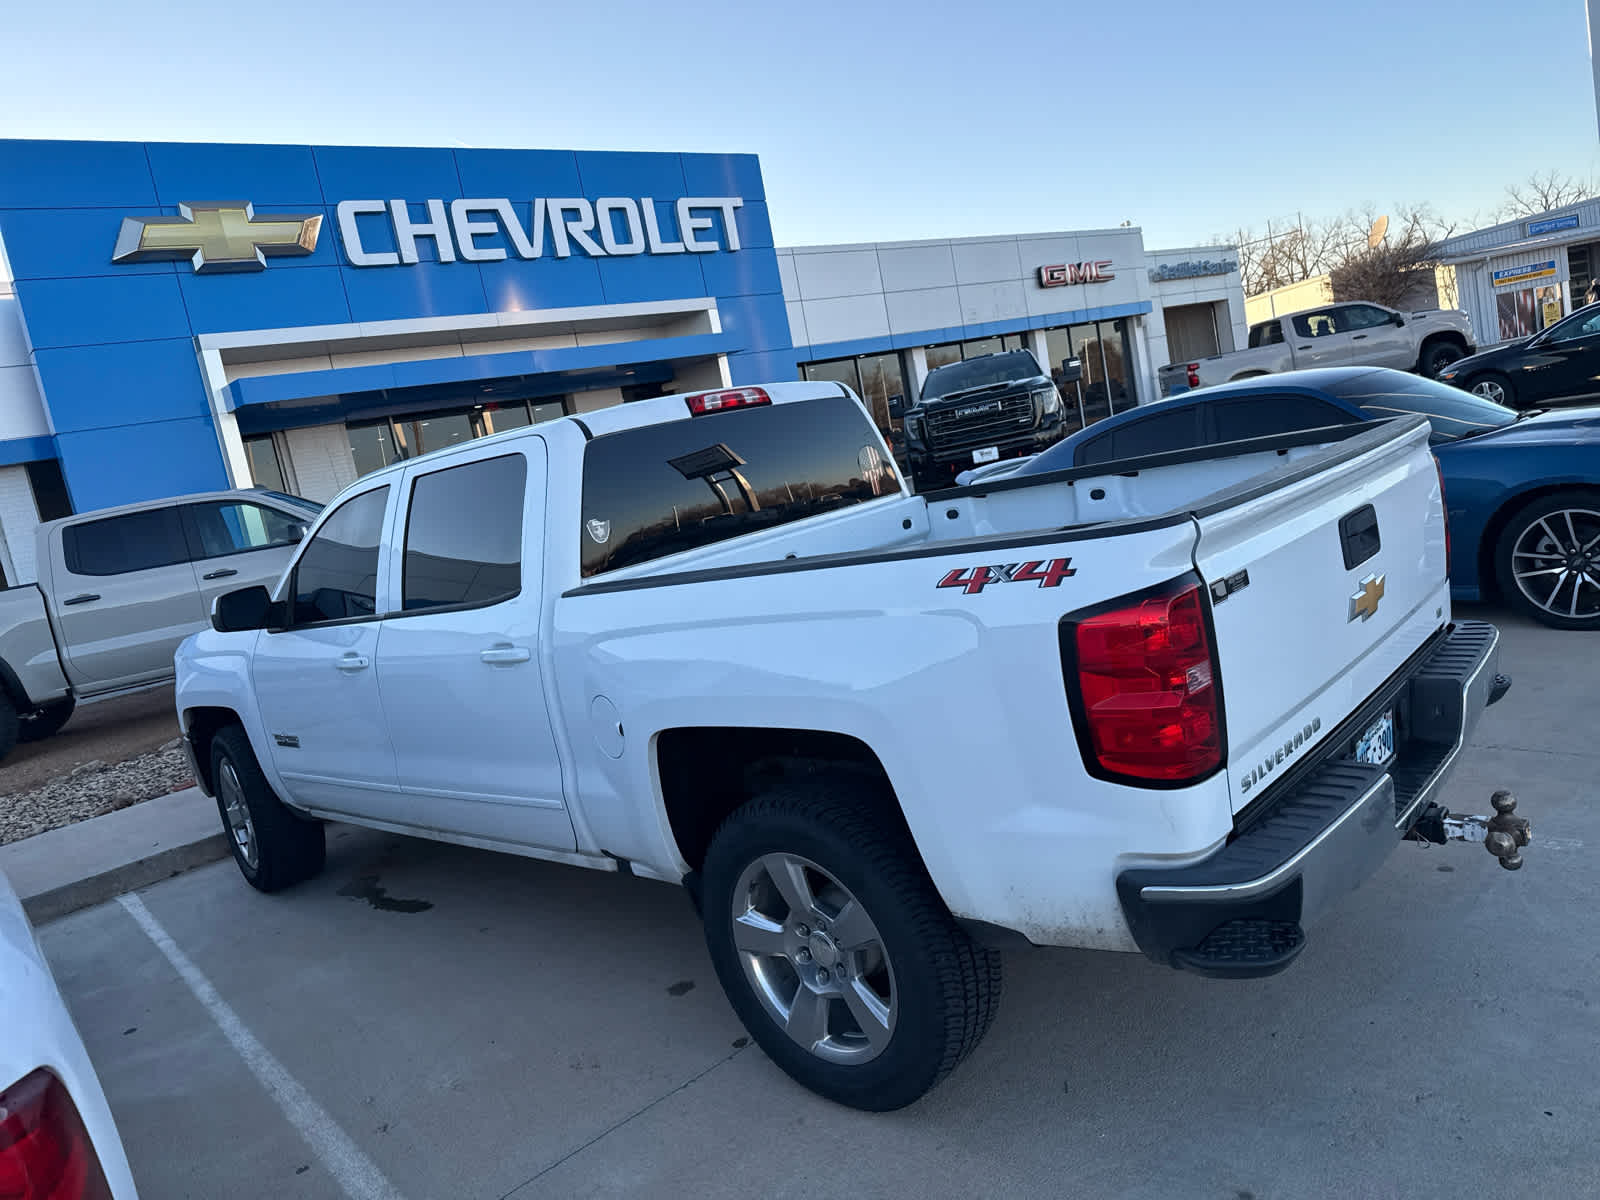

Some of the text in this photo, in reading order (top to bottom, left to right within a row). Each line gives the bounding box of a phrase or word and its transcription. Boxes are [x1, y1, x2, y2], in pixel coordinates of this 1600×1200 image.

[336, 197, 744, 267] CHEVROLET
[1038, 259, 1115, 288] GMC
[1499, 266, 1532, 279] EXPRESS
[1241, 716, 1321, 794] SILVERADO
